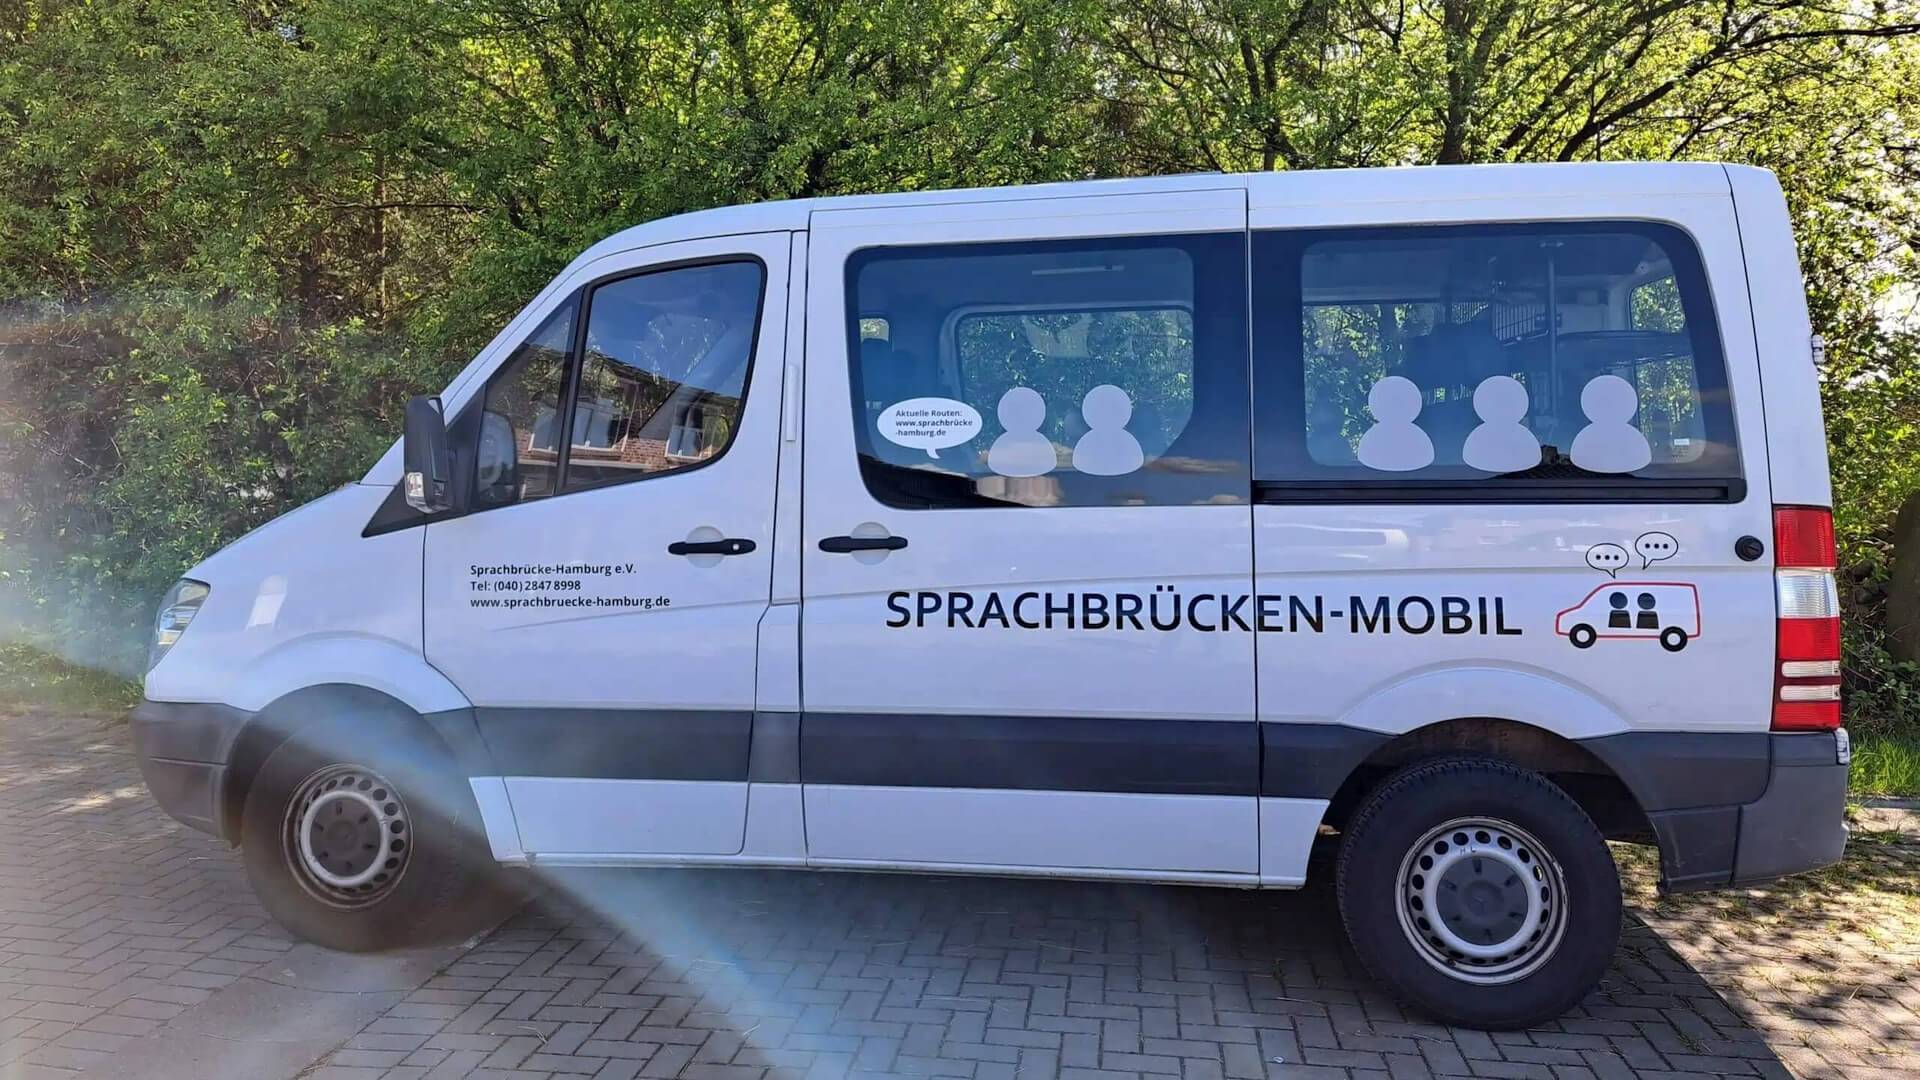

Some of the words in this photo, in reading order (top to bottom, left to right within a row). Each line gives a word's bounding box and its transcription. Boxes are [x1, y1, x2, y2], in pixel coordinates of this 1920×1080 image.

[896, 428, 946, 438] -hamburg.de
[470, 563, 612, 577] Sprachbrücke-Hamburg
[615, 564, 637, 574] e.V.
[470, 581, 491, 591] Tel:
[553, 580, 581, 590] 8998
[470, 595, 671, 610] www.sprachbruecke-hamburg.de
[886, 585, 1523, 636] SPRACHBRÜCKEN-MOBIL
